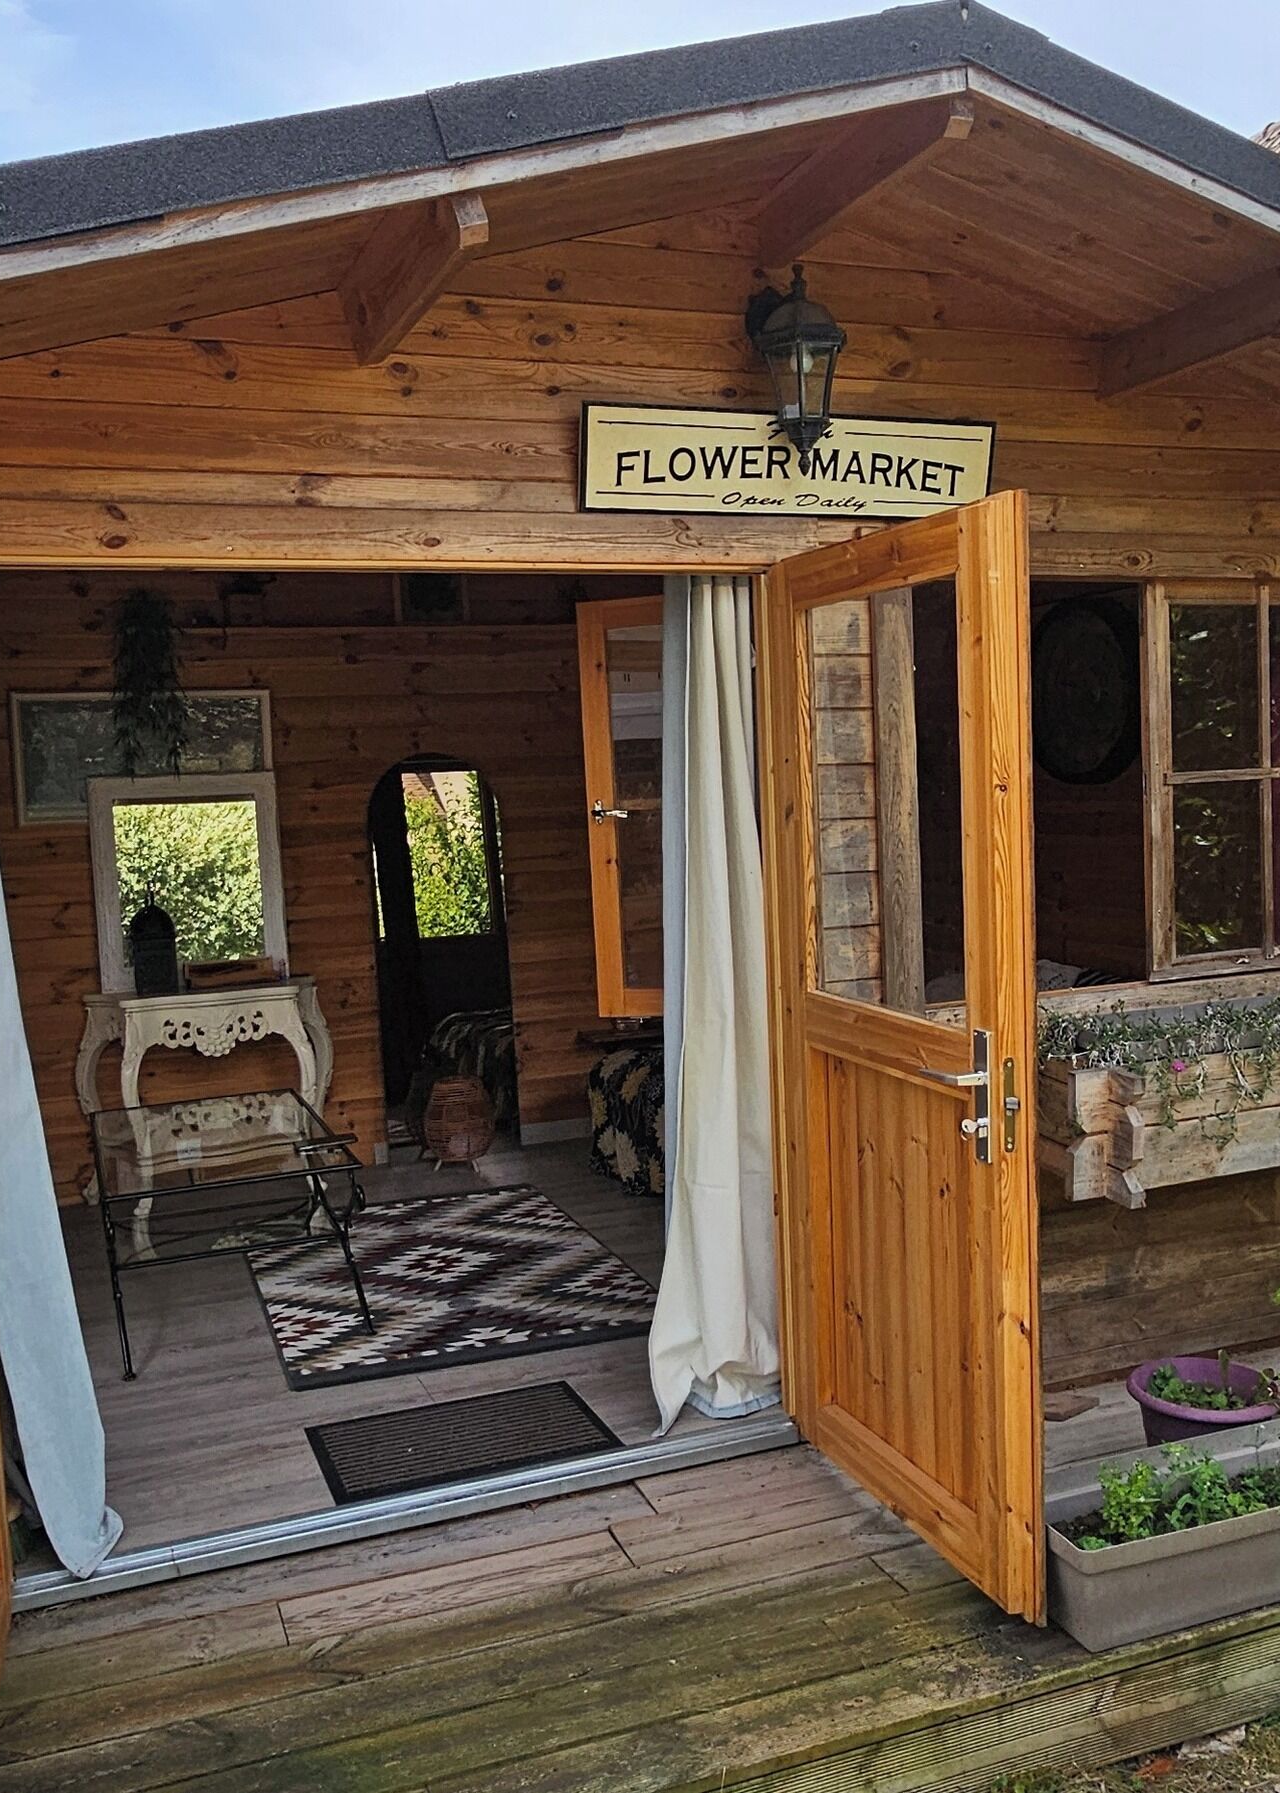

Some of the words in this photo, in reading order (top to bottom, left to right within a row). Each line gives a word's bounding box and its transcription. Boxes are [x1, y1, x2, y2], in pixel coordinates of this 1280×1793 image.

[615, 445, 791, 486] FLOWER
[810, 447, 965, 496] MARKET
[721, 491, 786, 507] Open
[795, 493, 867, 512] Daily
